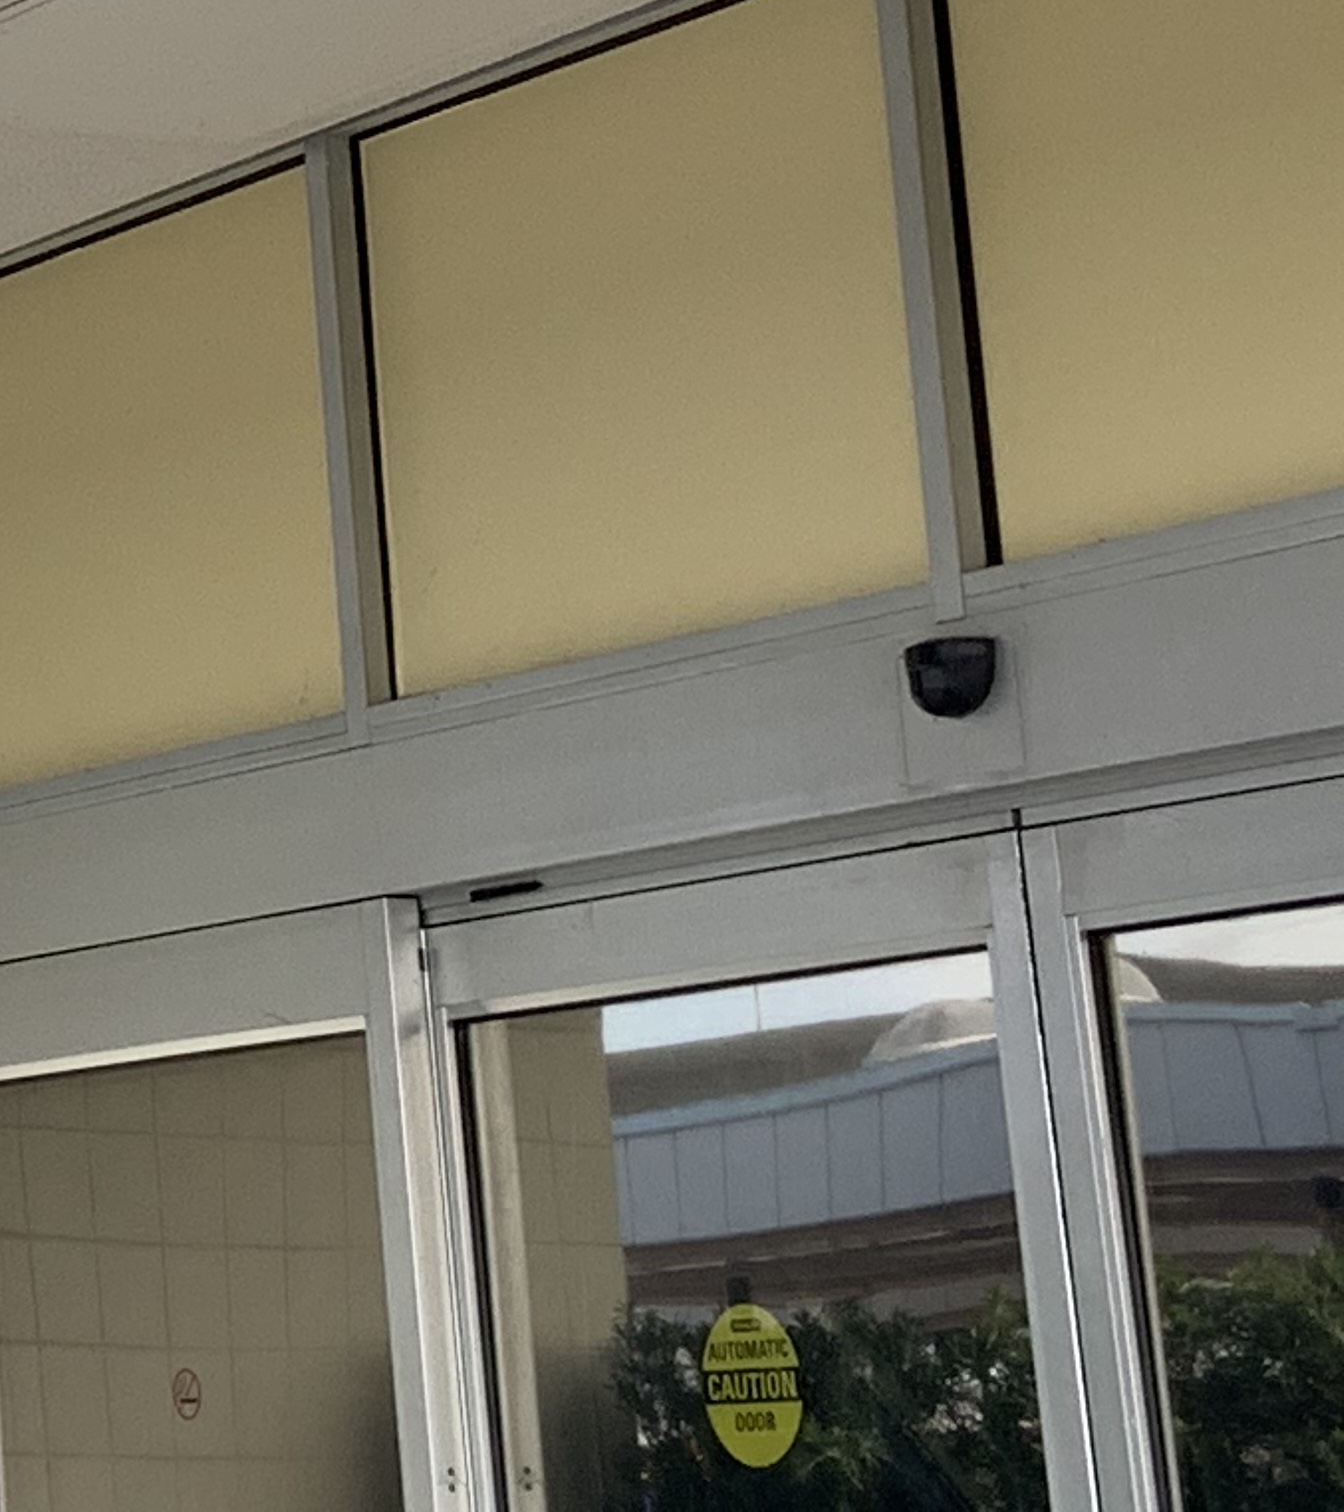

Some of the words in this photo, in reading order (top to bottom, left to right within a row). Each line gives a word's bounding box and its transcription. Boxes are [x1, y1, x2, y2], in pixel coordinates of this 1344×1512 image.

[708, 1339, 789, 1362] AUTOMATIC
[707, 1369, 798, 1402] CAUTION
[734, 1411, 777, 1433] DOOR
